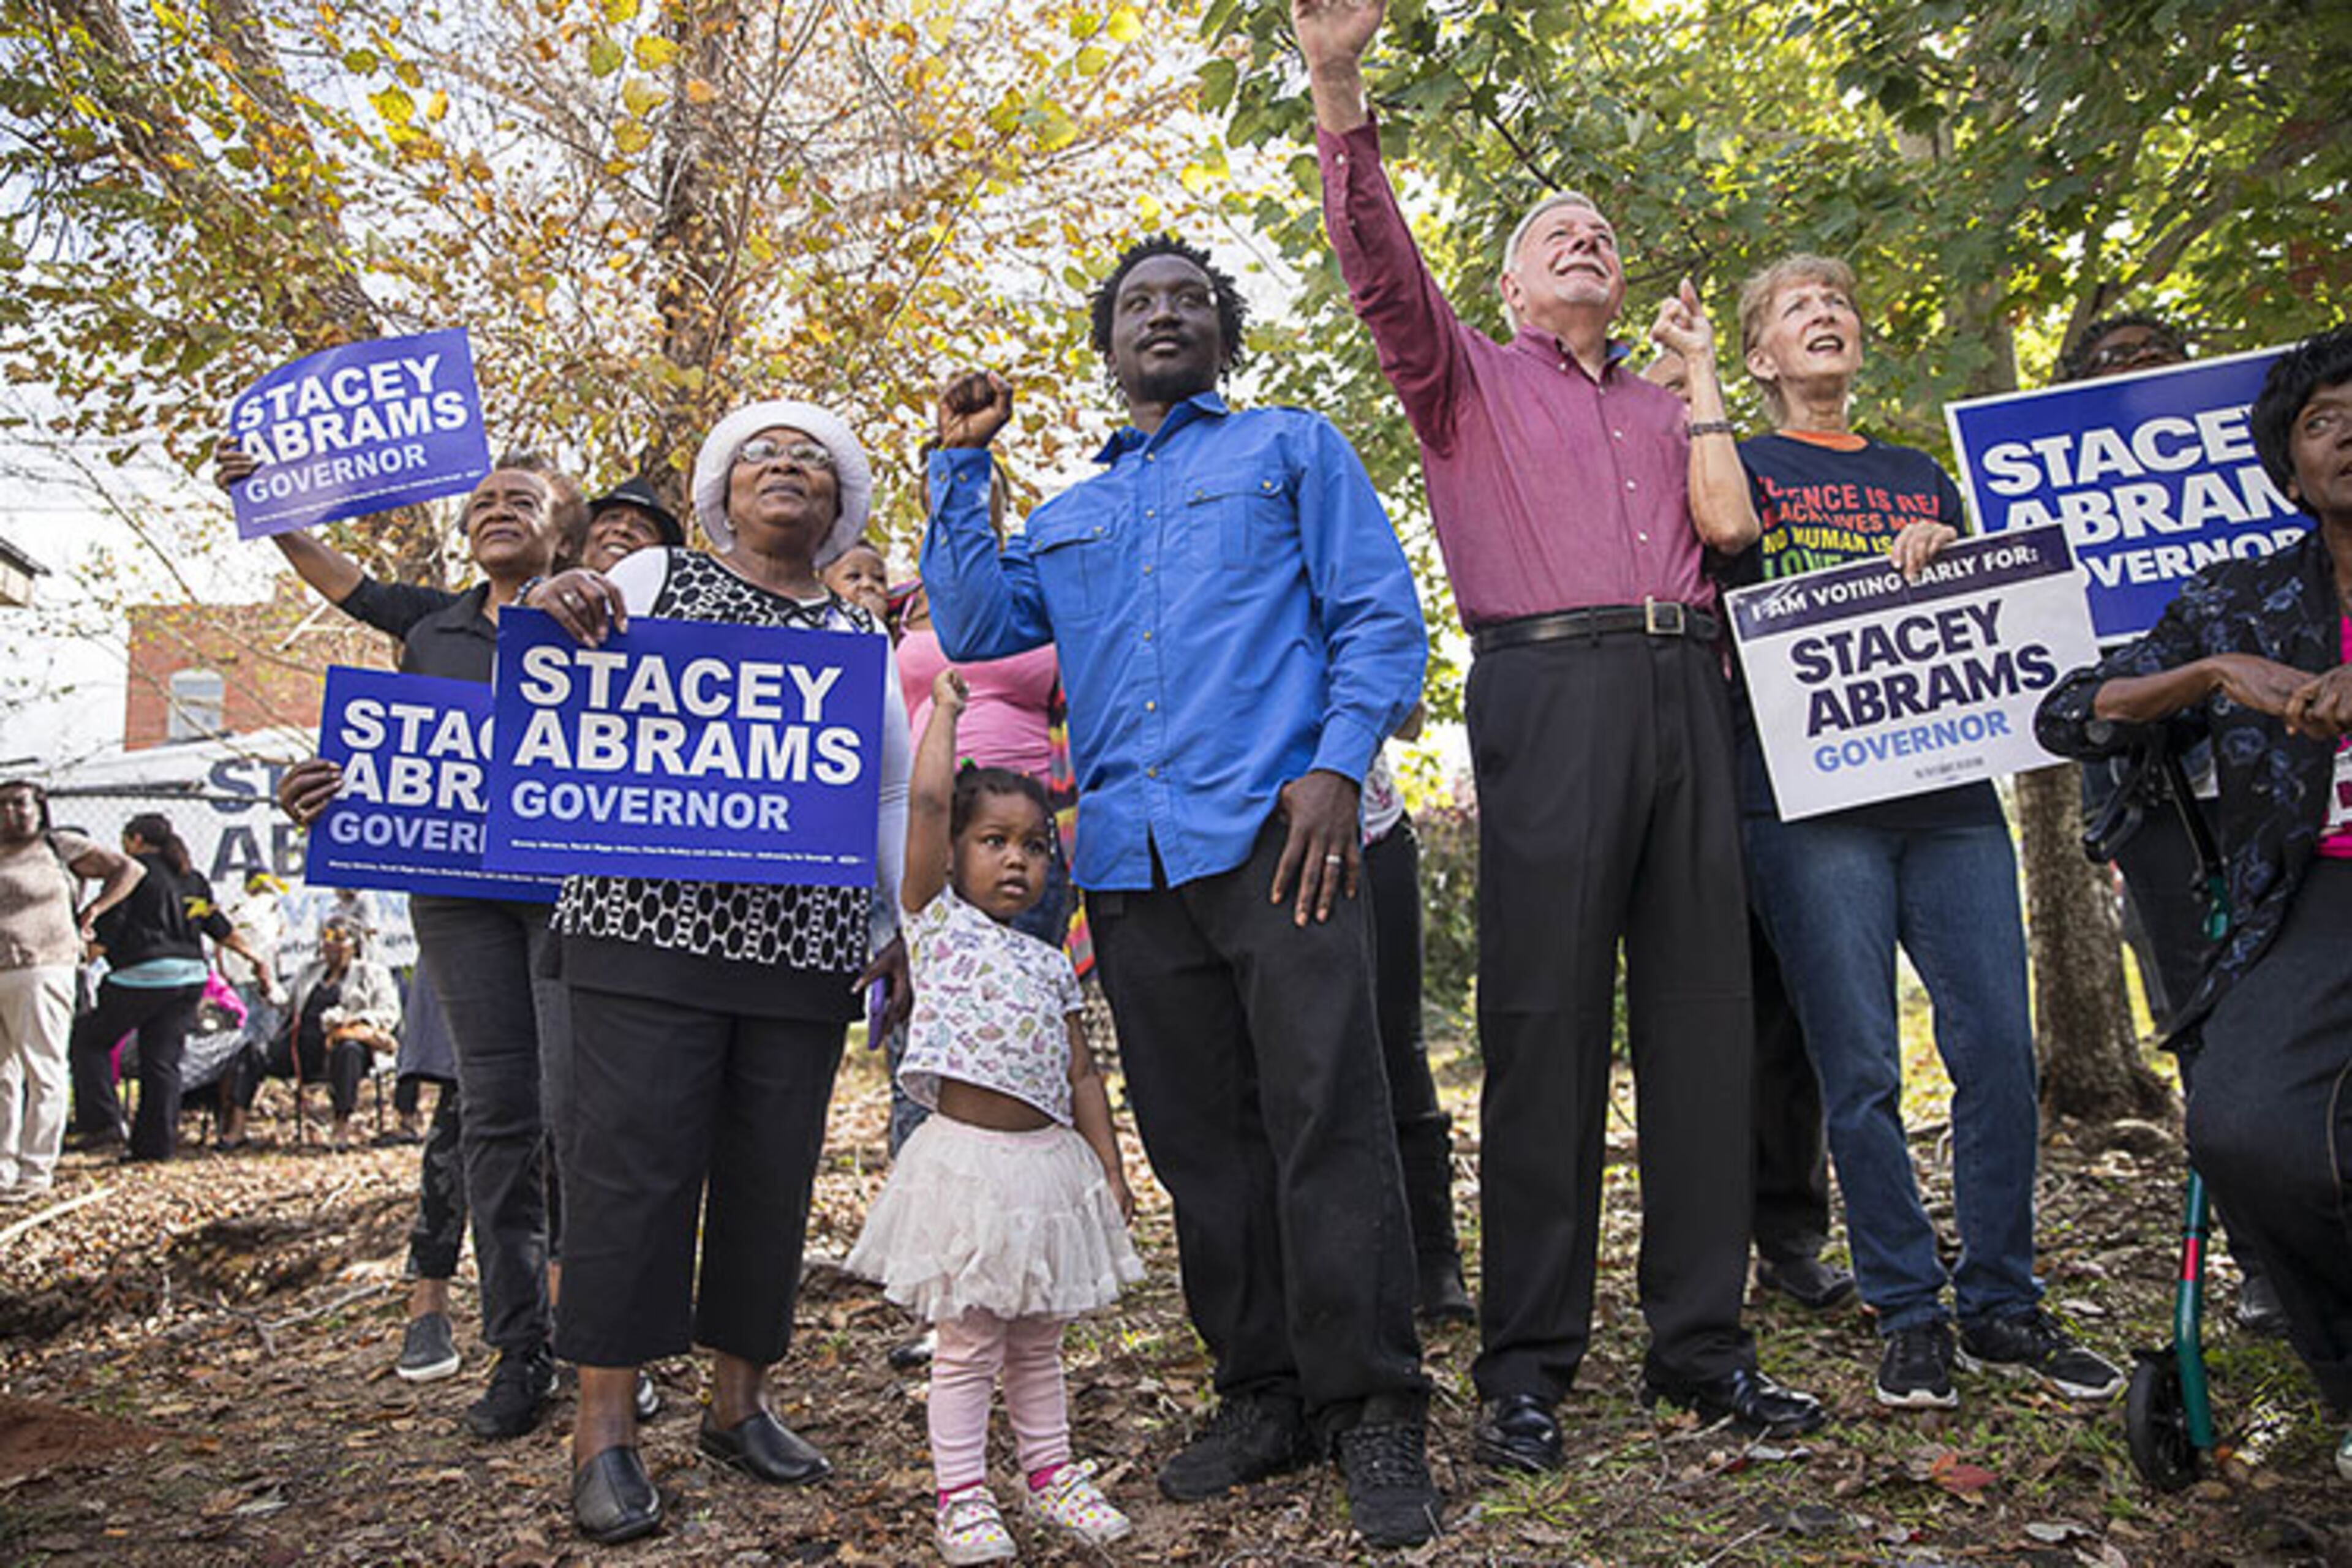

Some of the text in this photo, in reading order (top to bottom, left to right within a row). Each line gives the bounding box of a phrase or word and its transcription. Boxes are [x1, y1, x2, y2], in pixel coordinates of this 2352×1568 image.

[237, 354, 440, 430] STACEY
[241, 391, 469, 465] ABRAMS
[246, 443, 427, 503] GOVERNOR
[1982, 404, 2255, 496] STACE
[2007, 466, 2299, 546] ABRA
[1768, 591, 1807, 619] AM
[1811, 573, 1901, 606] VOTING
[1909, 556, 1977, 587] ARLY
[1982, 545, 2039, 571] FOR:
[2082, 527, 2306, 588] VERNO
[1791, 598, 2003, 684] STACEY
[519, 645, 843, 722] STACEY
[1807, 644, 2058, 737] ABRAMS
[341, 698, 494, 761] STA
[513, 709, 862, 785] ABRAMS
[1814, 709, 2011, 772] GOVERNOR
[334, 752, 489, 813] ABR
[511, 780, 790, 831] GOVERNOR
[329, 811, 486, 854] GOVER
